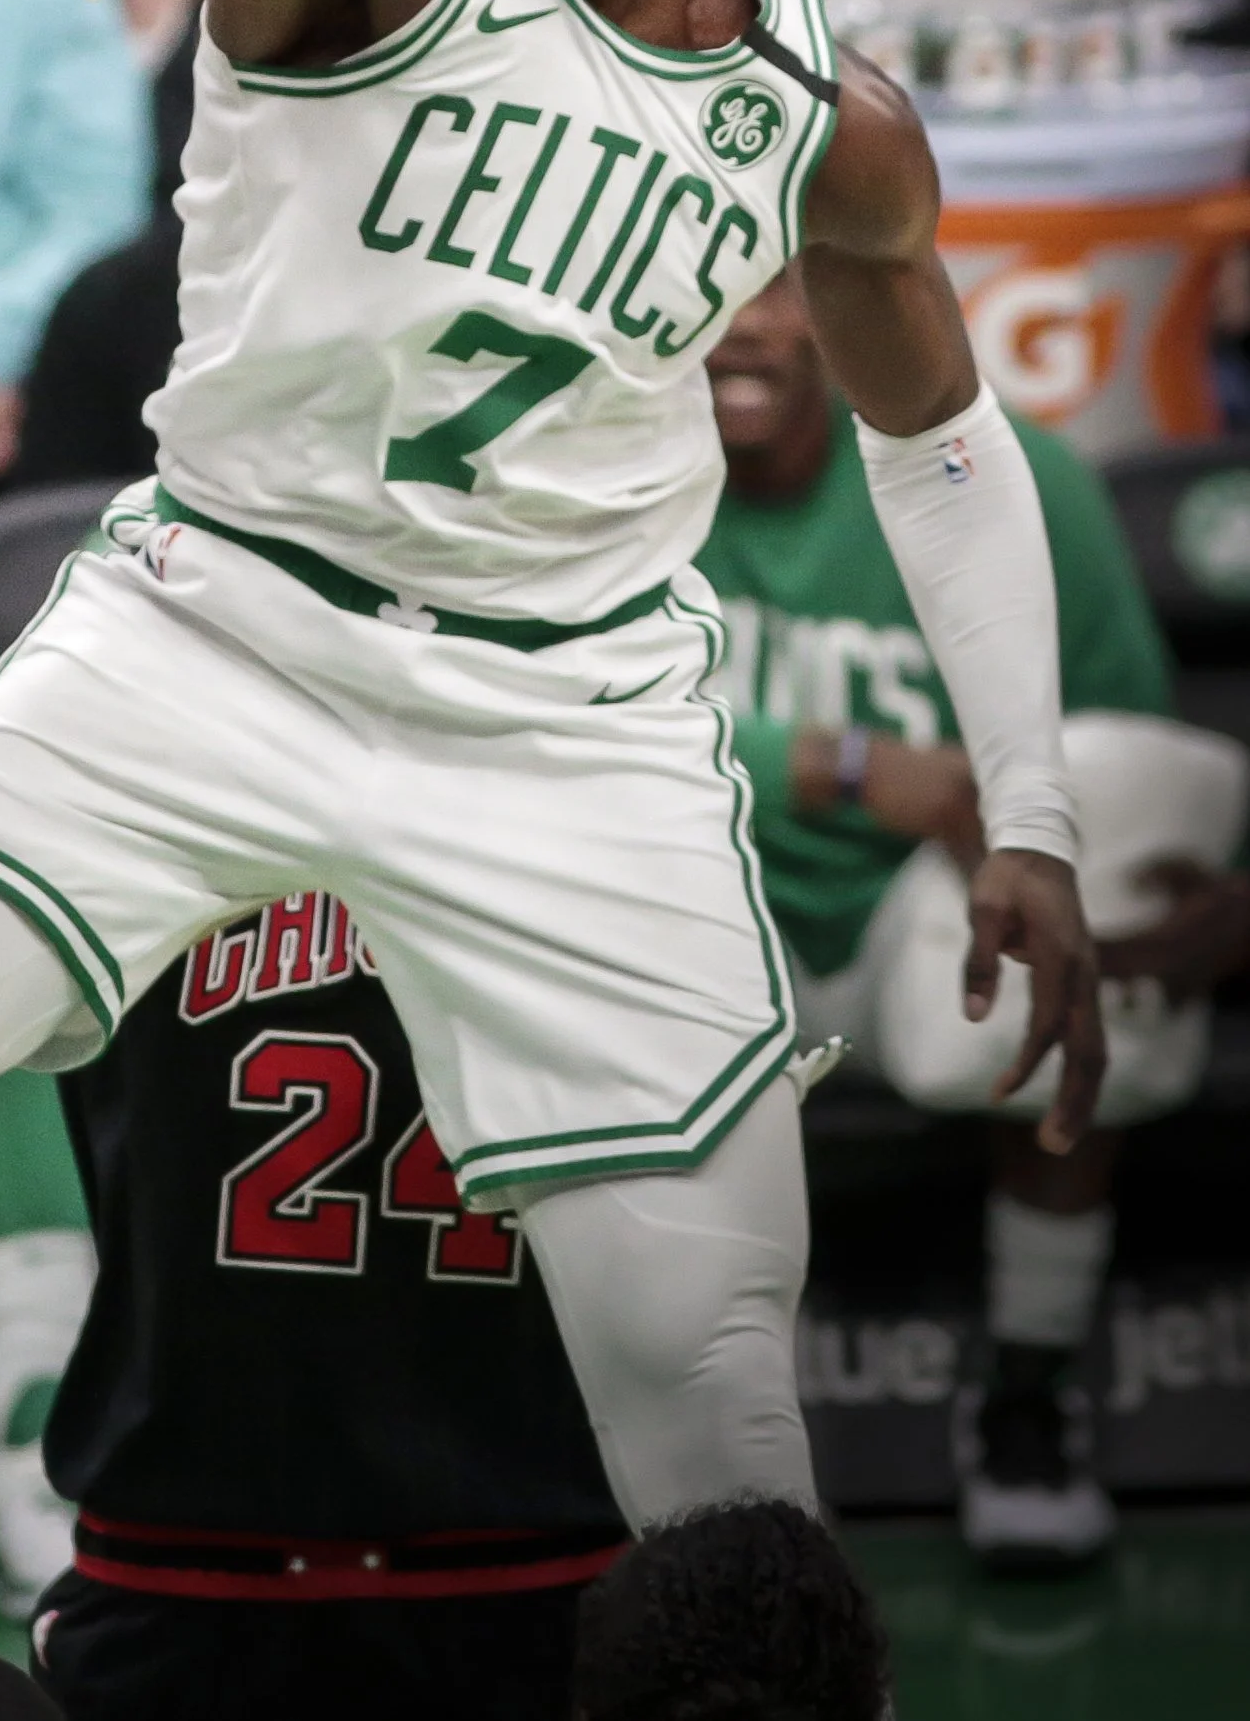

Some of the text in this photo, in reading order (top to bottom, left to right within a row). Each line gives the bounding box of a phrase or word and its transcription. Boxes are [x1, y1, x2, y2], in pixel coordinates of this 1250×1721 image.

[358, 94, 759, 358] CELTICS
[383, 310, 597, 494] 7
[178, 890, 380, 1026] CHI
[216, 1029, 524, 1285] 24
